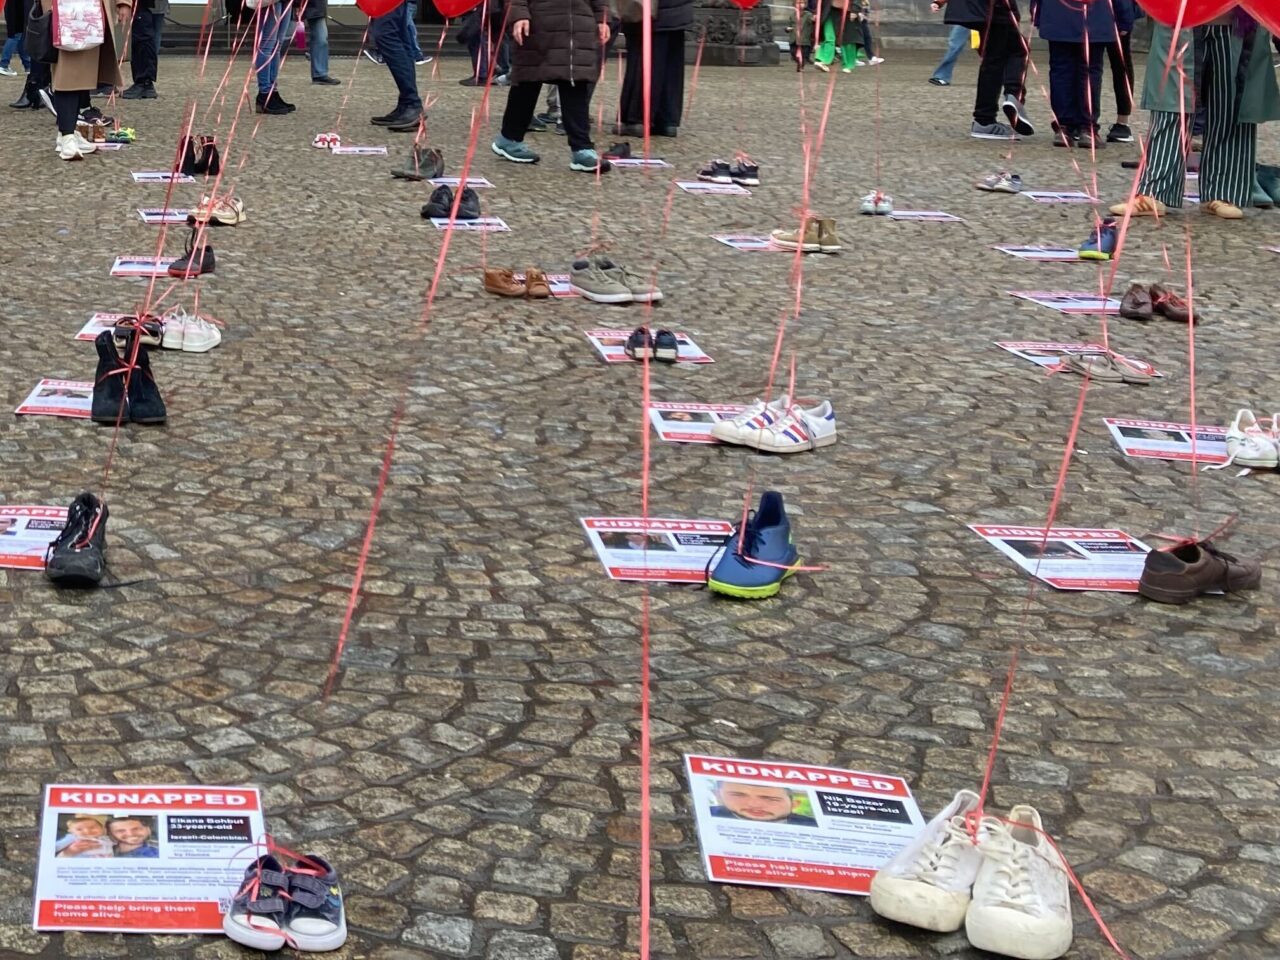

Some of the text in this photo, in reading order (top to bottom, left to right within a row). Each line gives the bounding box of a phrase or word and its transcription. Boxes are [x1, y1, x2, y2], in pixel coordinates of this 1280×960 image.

[593, 520, 724, 530] KIDNAPPED
[985, 528, 1120, 538] KIDNAPPED
[700, 761, 895, 791] KIDNAPPED
[60, 791, 247, 806] KIDNAPPED
[827, 806, 864, 815] Israeli
[724, 858, 767, 868] Please
[770, 863, 798, 872] help
[800, 866, 835, 876] bring
[725, 866, 762, 875] home
[98, 904, 126, 912] help
[128, 905, 161, 913] bring
